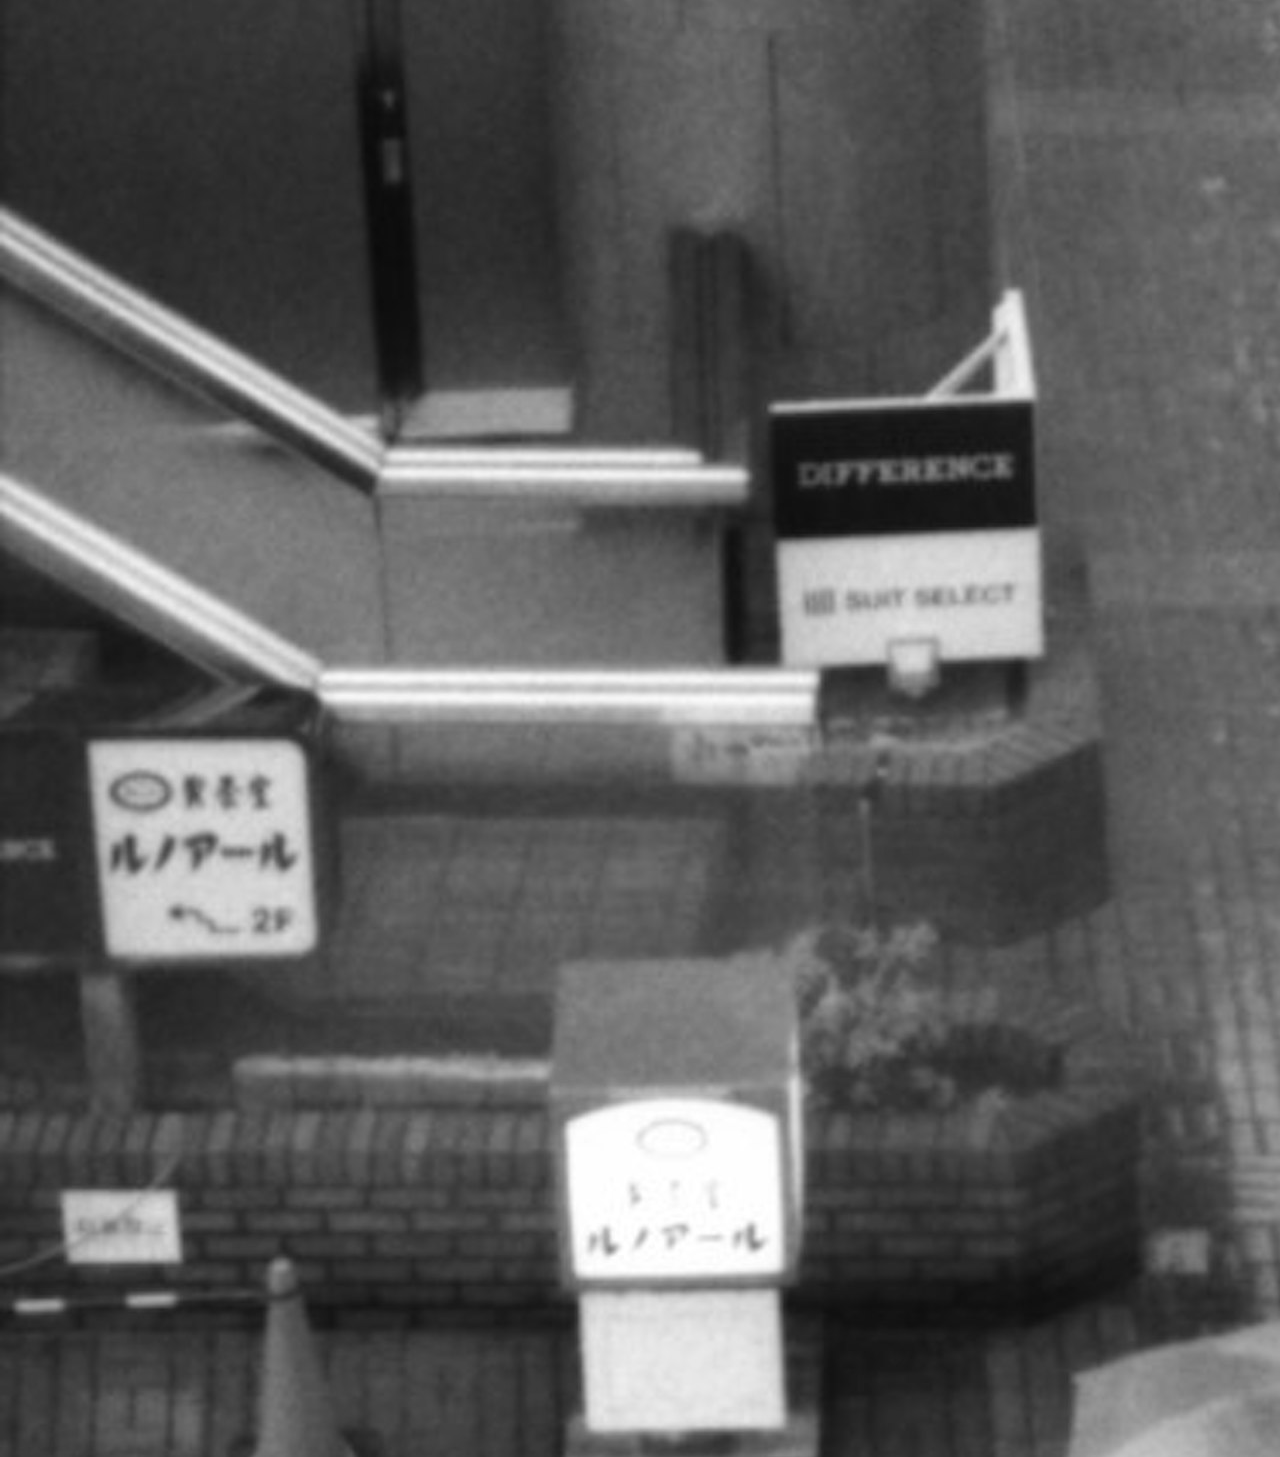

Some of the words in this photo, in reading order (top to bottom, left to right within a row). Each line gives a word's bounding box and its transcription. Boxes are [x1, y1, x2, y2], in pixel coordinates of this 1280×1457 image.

[799, 453, 1015, 486] DIFFERENCE
[845, 589, 904, 611] SUIT
[914, 584, 1015, 608] SELECT
[109, 832, 297, 875] ルノアール
[252, 907, 293, 934] 2F
[587, 1222, 768, 1257] ルノアール
